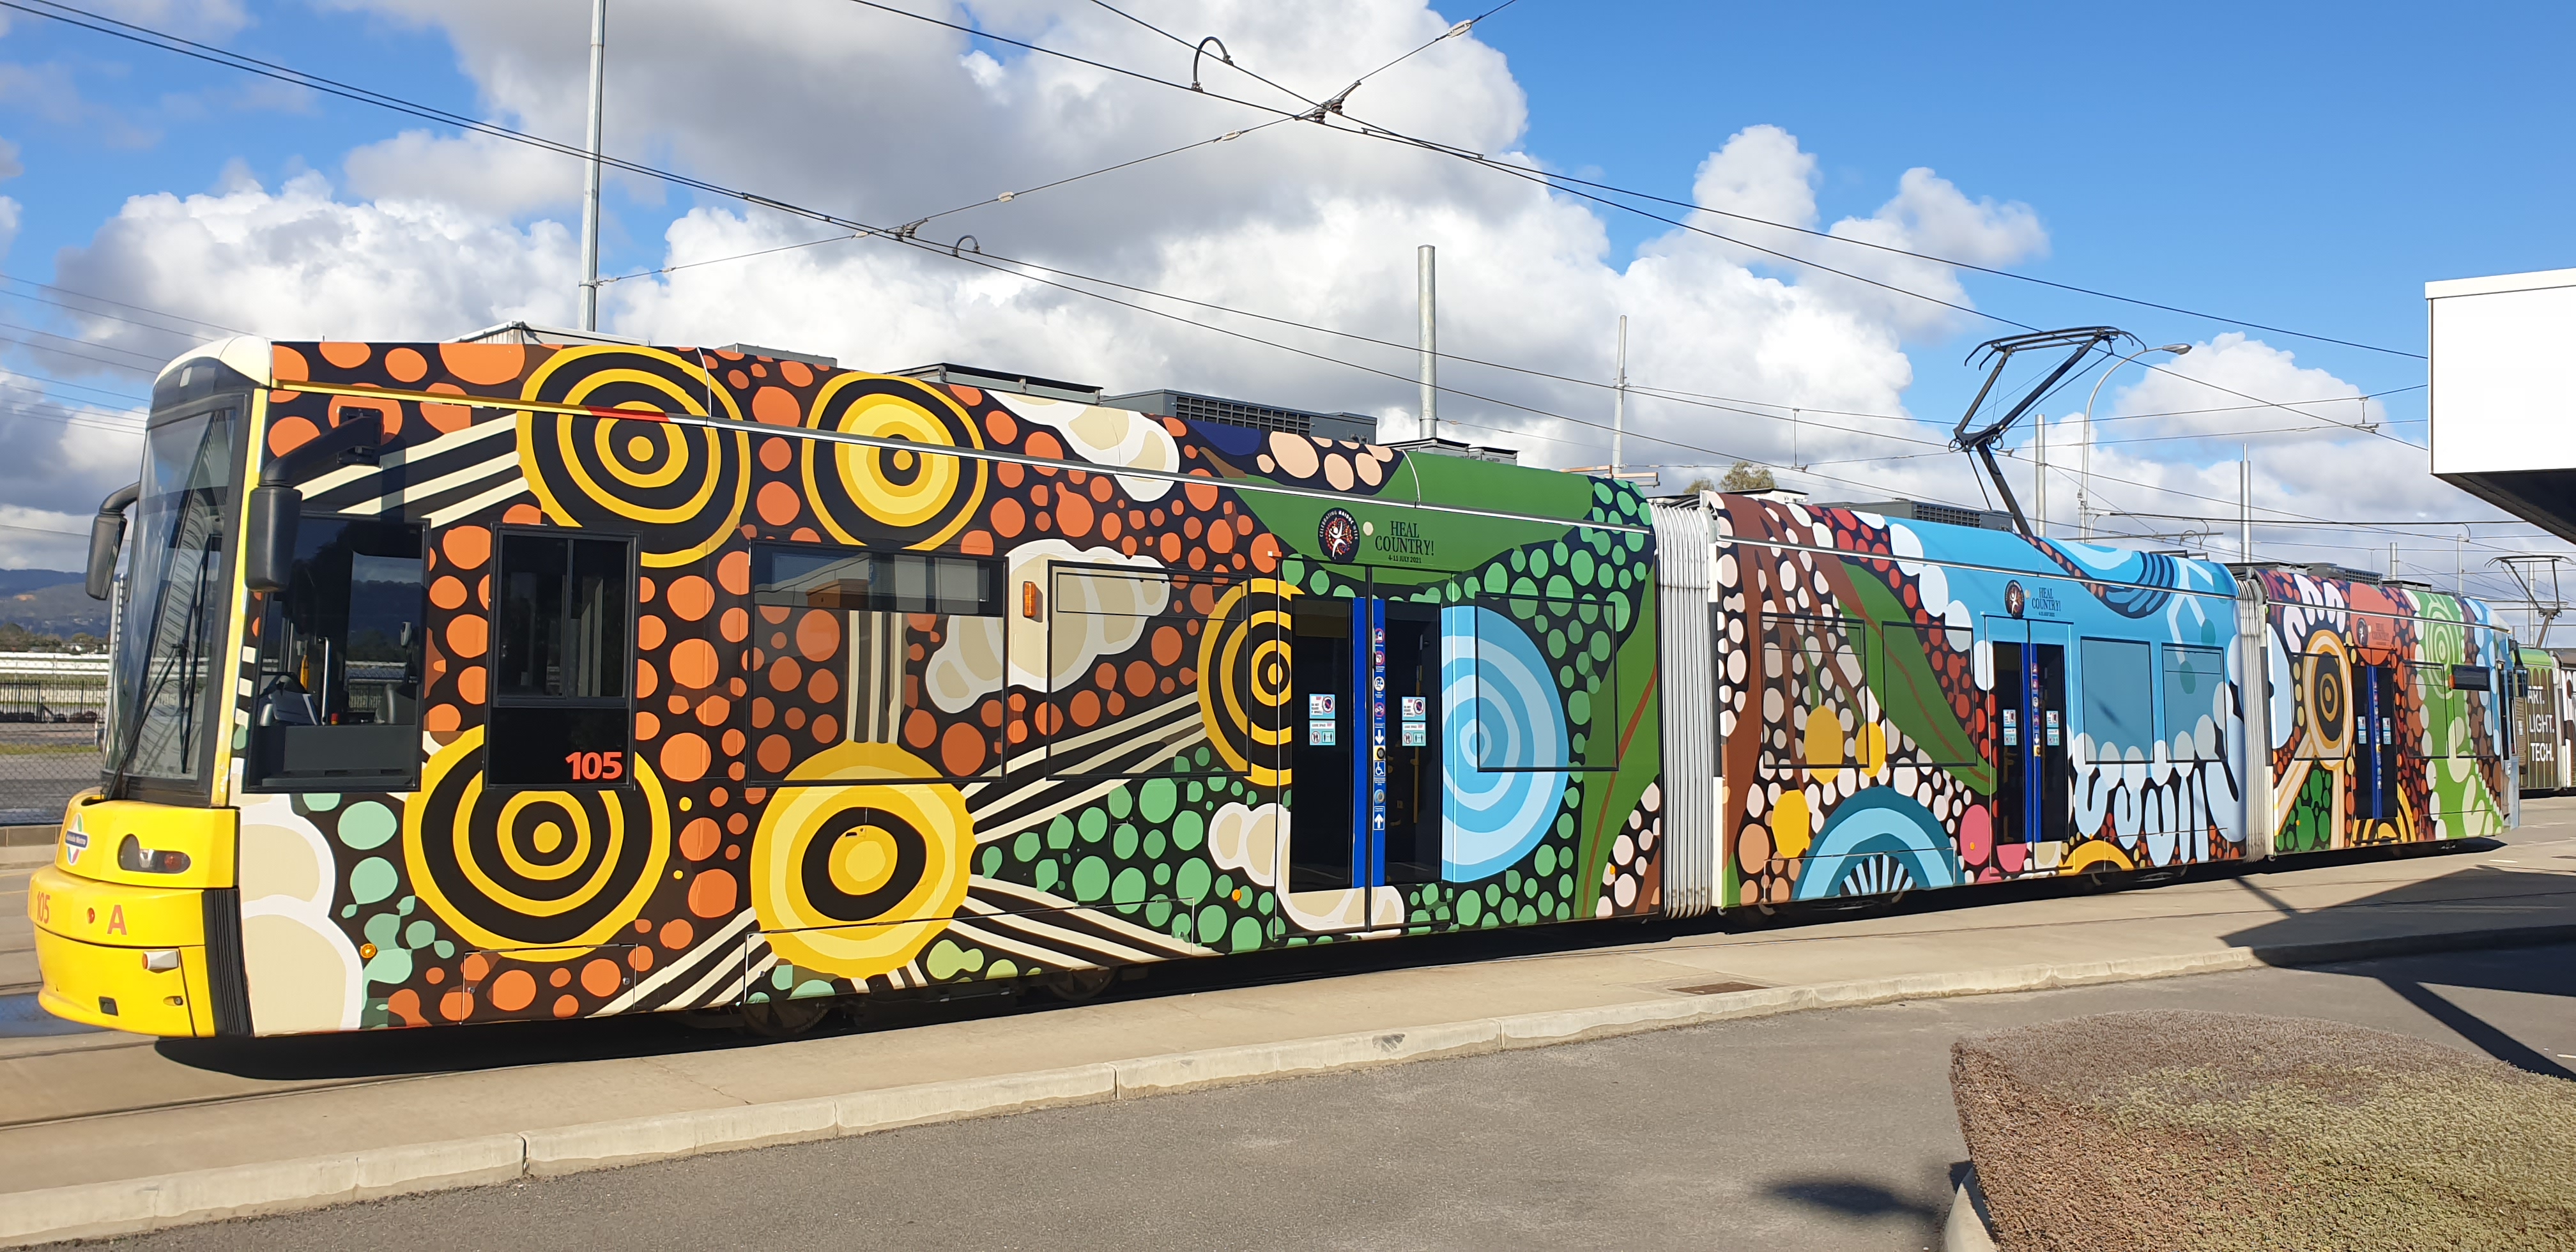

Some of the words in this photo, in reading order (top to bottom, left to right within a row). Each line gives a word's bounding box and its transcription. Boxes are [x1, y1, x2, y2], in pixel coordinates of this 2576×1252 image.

[1390, 521, 1420, 538] HEAL
[1375, 535, 1434, 556] COUNTRY!
[2039, 587, 2053, 599] HEAL
[2032, 598, 2061, 611] COUNTRY!
[2527, 685, 2545, 705] ART.
[2528, 714, 2555, 733] LIGHT.
[2530, 742, 2554, 762] TECH.
[565, 752, 622, 779] 105
[37, 891, 50, 924] 105
[107, 905, 127, 935] A
